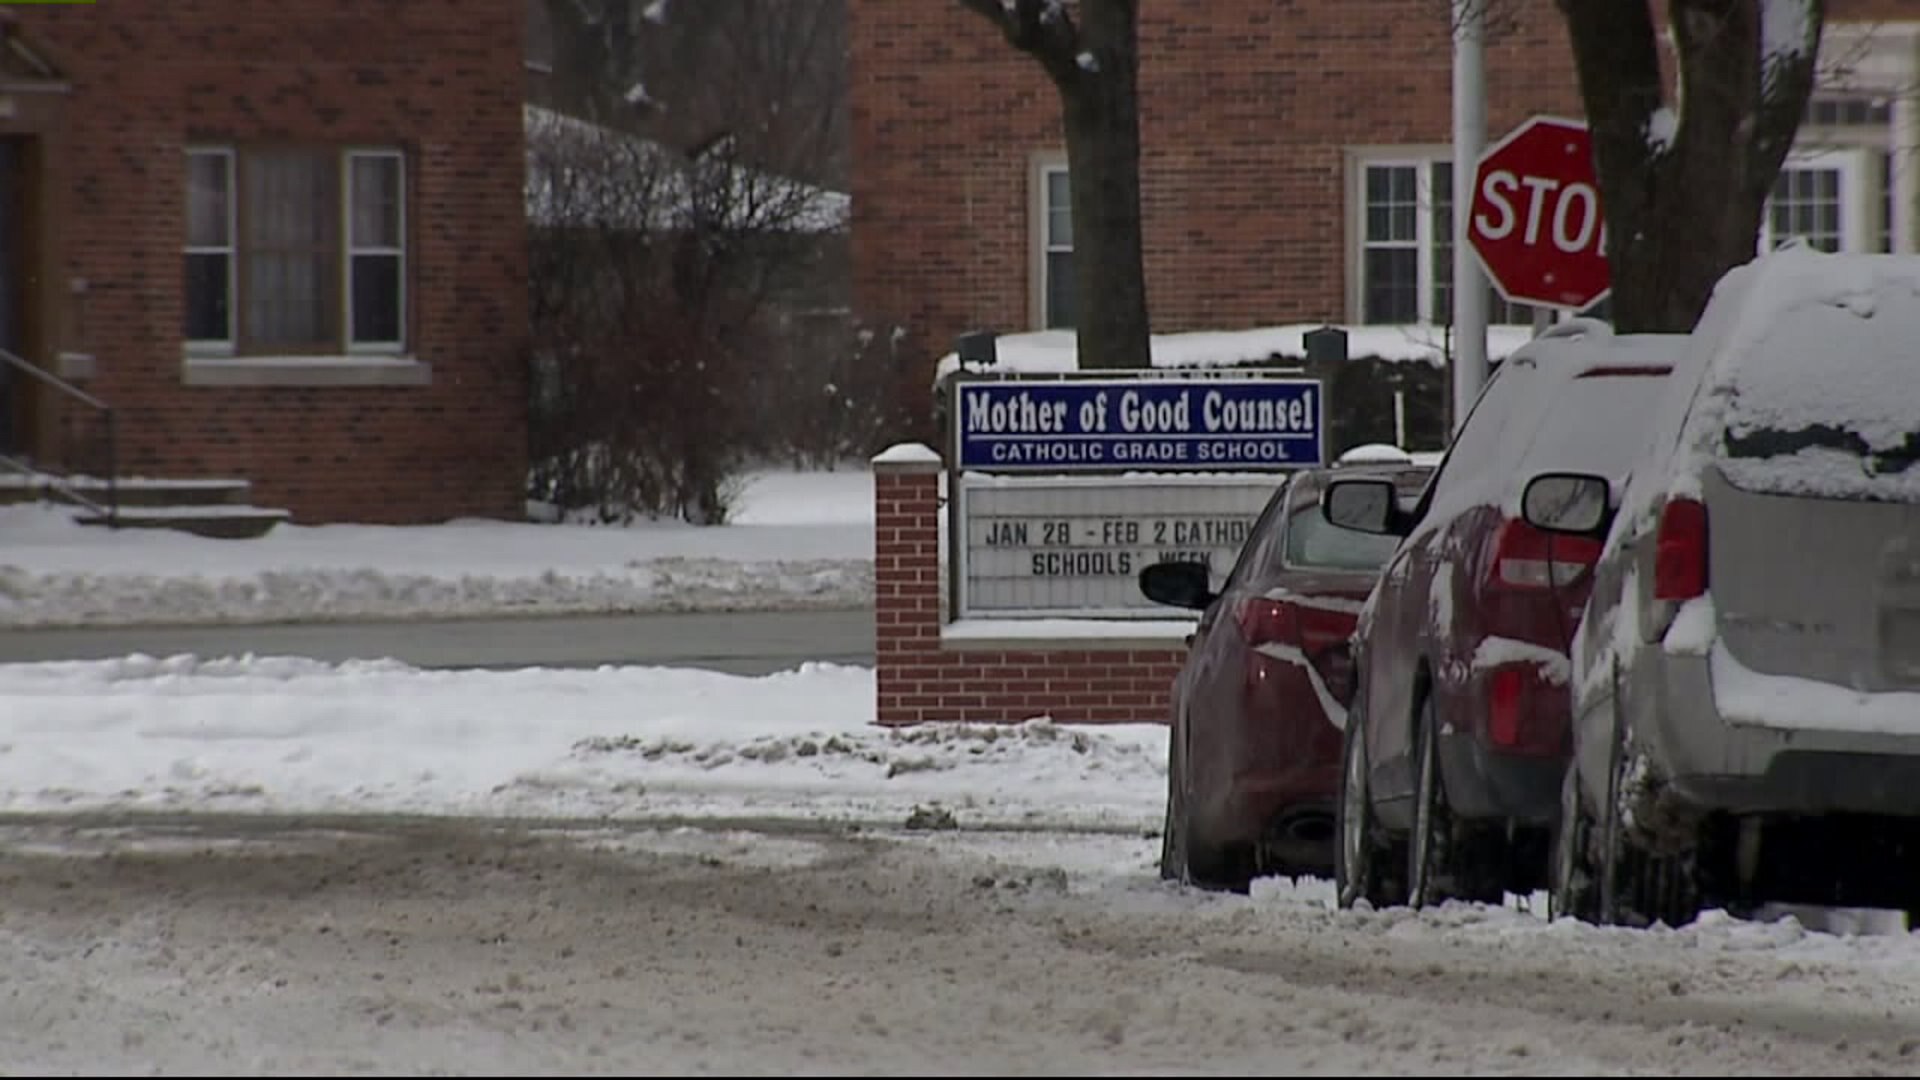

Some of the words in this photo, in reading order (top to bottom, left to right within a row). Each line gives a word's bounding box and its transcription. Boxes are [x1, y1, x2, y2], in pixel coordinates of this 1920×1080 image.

[1475, 169, 1607, 256] STO
[968, 391, 1067, 432] Mother
[1080, 391, 1107, 432] of
[1120, 390, 1190, 431] Good
[1203, 389, 1313, 430] Counsel
[992, 443, 1103, 460] CATHOLIC
[1112, 442, 1188, 459] GRADE
[1198, 442, 1289, 459] SCHOOL
[986, 522, 1027, 545] JAN
[1043, 522, 1070, 545] 28
[1153, 521, 1166, 544] 2
